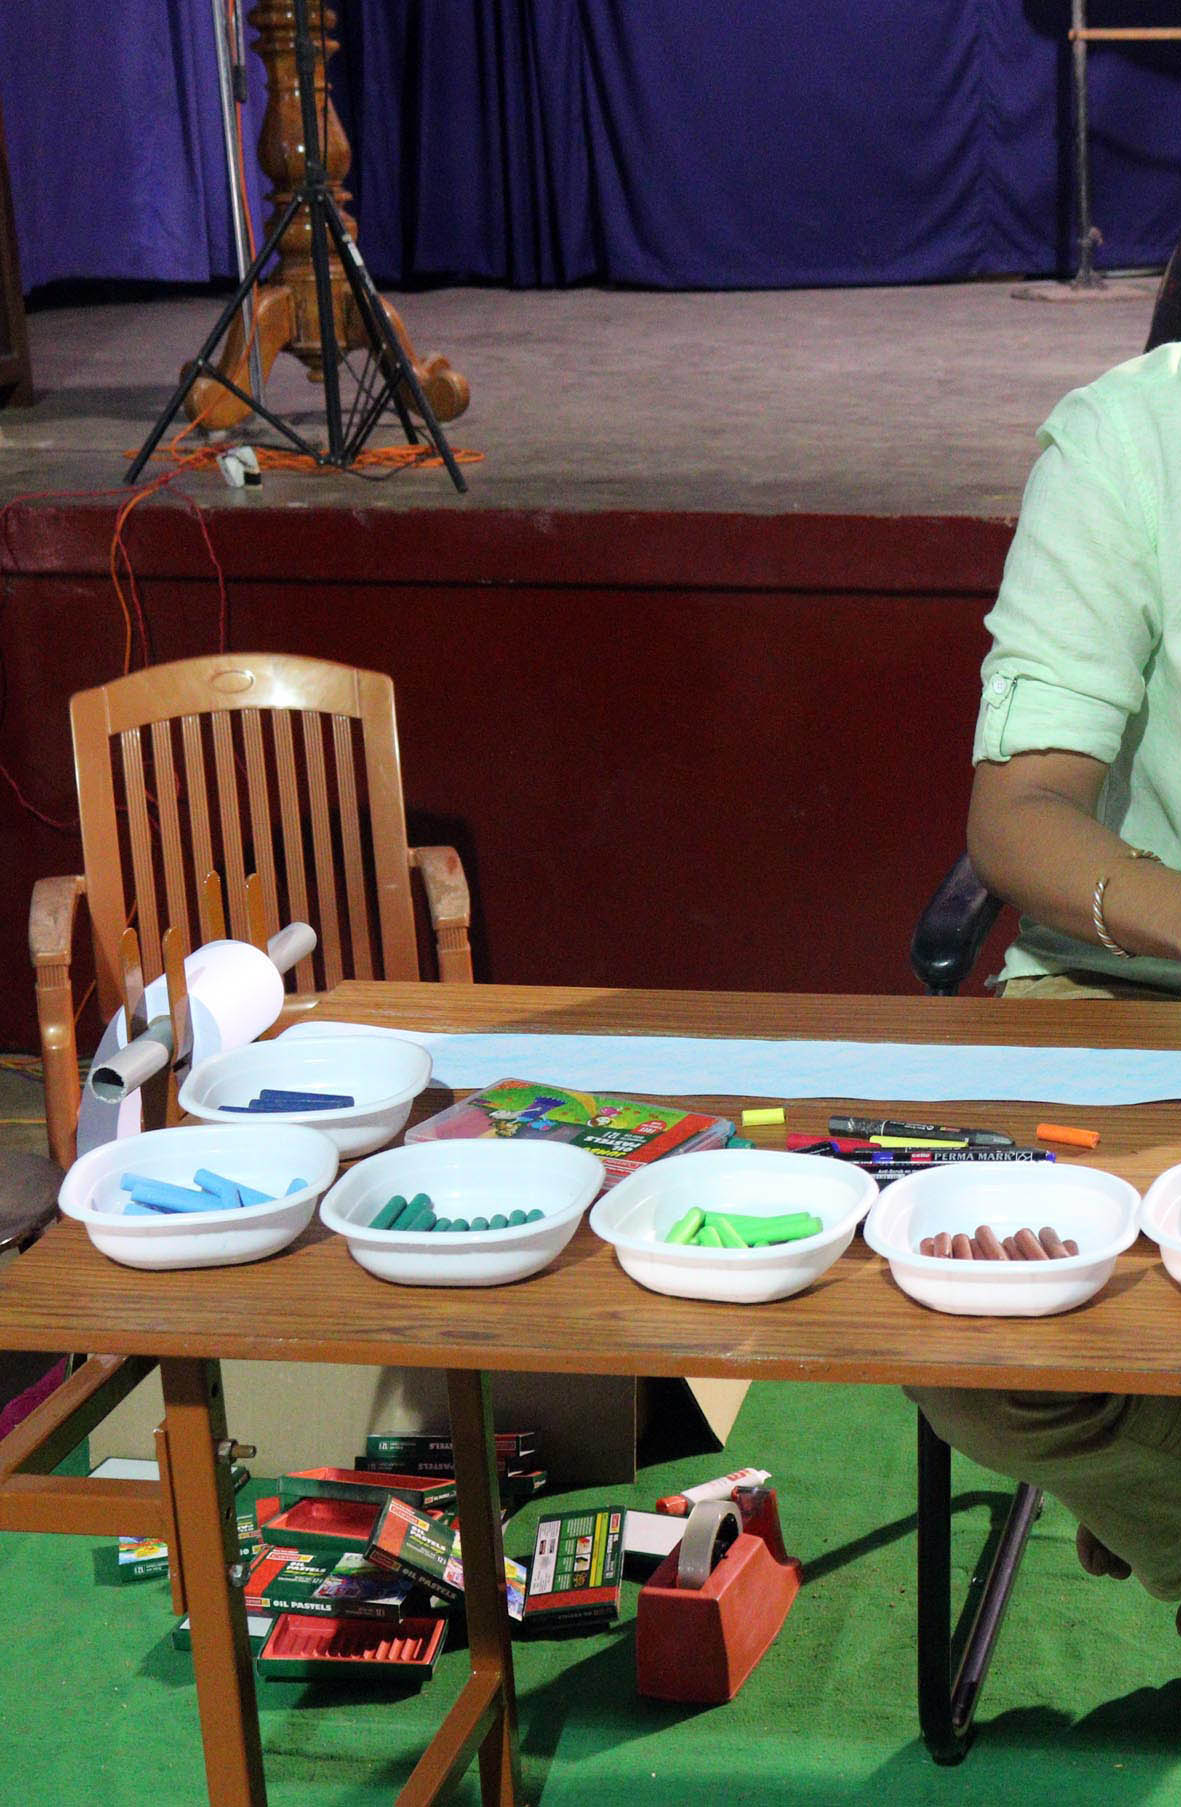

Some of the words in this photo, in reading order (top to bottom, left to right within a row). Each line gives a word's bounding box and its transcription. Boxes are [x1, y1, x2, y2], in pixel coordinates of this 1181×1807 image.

[582, 1135, 642, 1148] PASTELS
[934, 1151, 975, 1161] PERMA
[977, 1151, 1013, 1161] MARK
[273, 1599, 290, 1608] OIL
[291, 1601, 333, 1612] PASTELS
